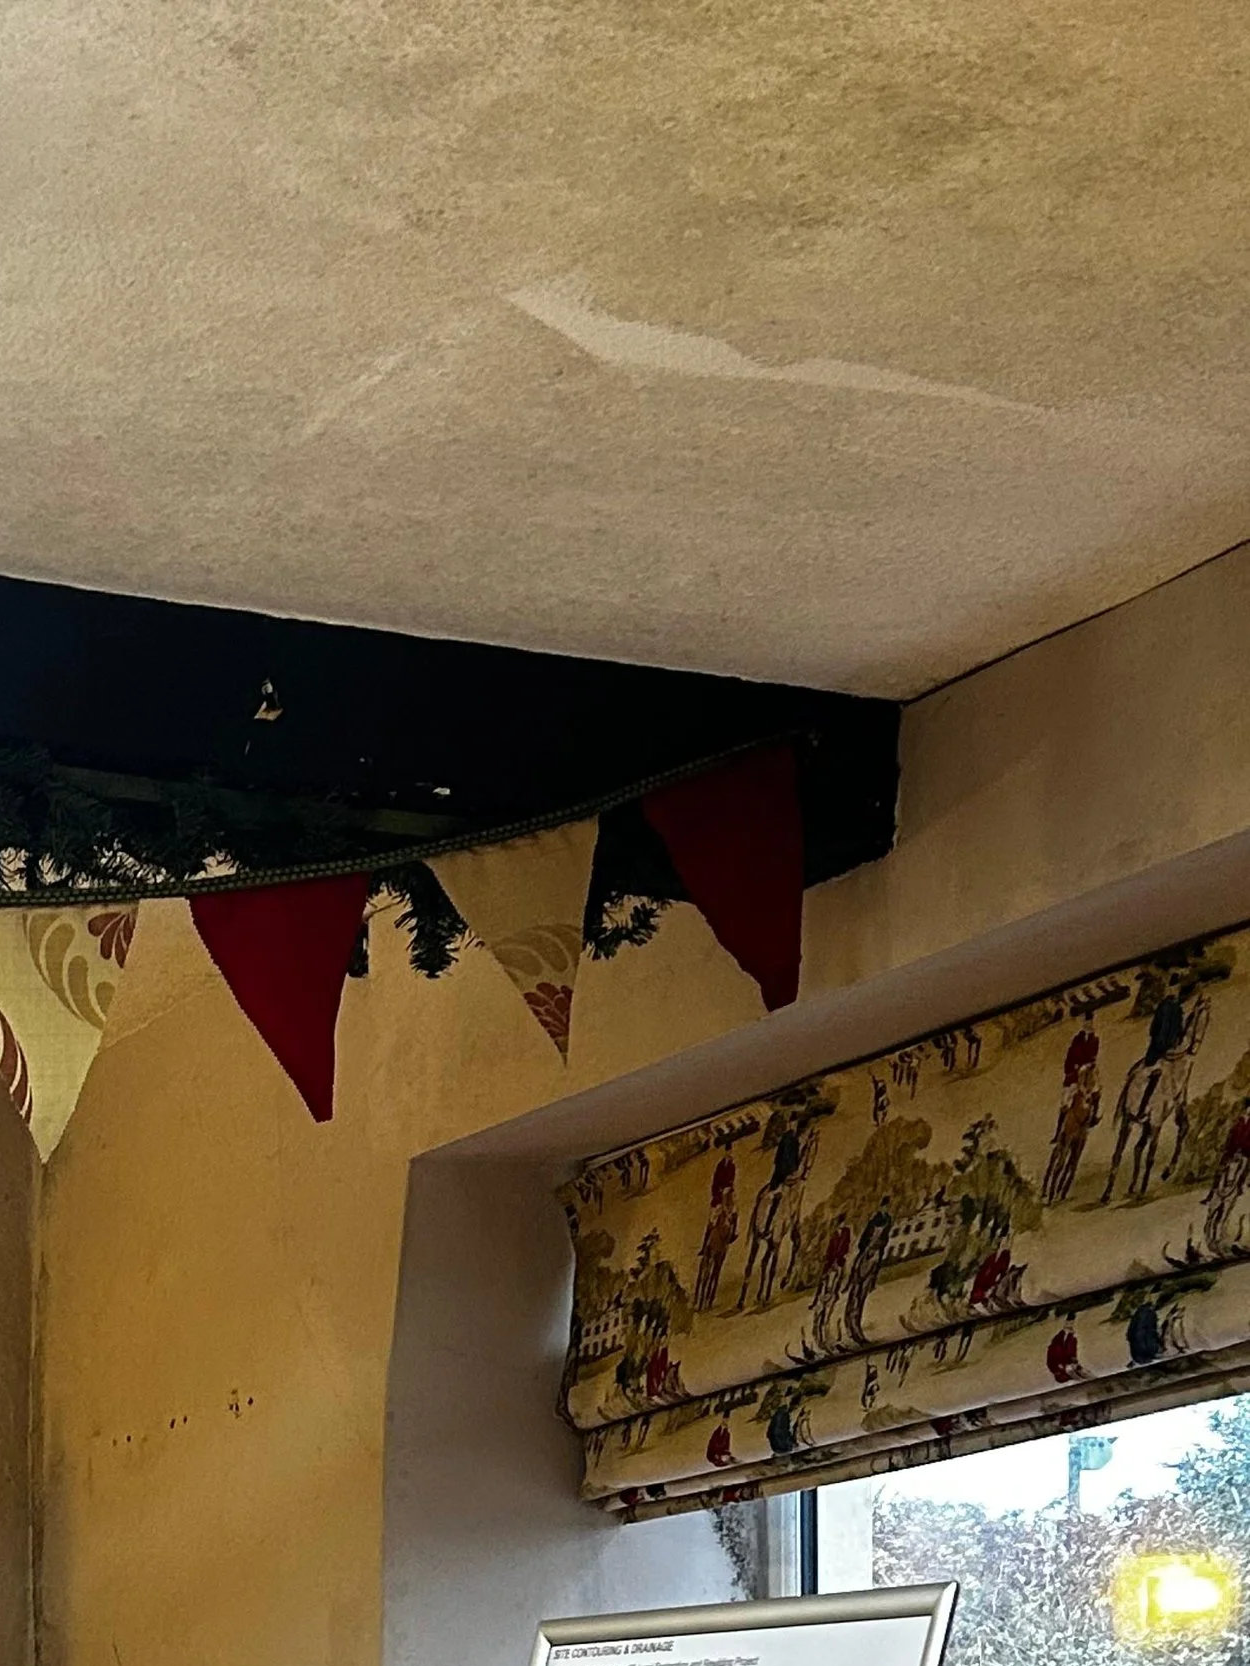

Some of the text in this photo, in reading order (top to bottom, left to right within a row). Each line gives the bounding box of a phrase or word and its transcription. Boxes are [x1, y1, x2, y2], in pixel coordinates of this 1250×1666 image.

[553, 1640, 674, 1659] SITE CONTOURING & DRAINAGE
